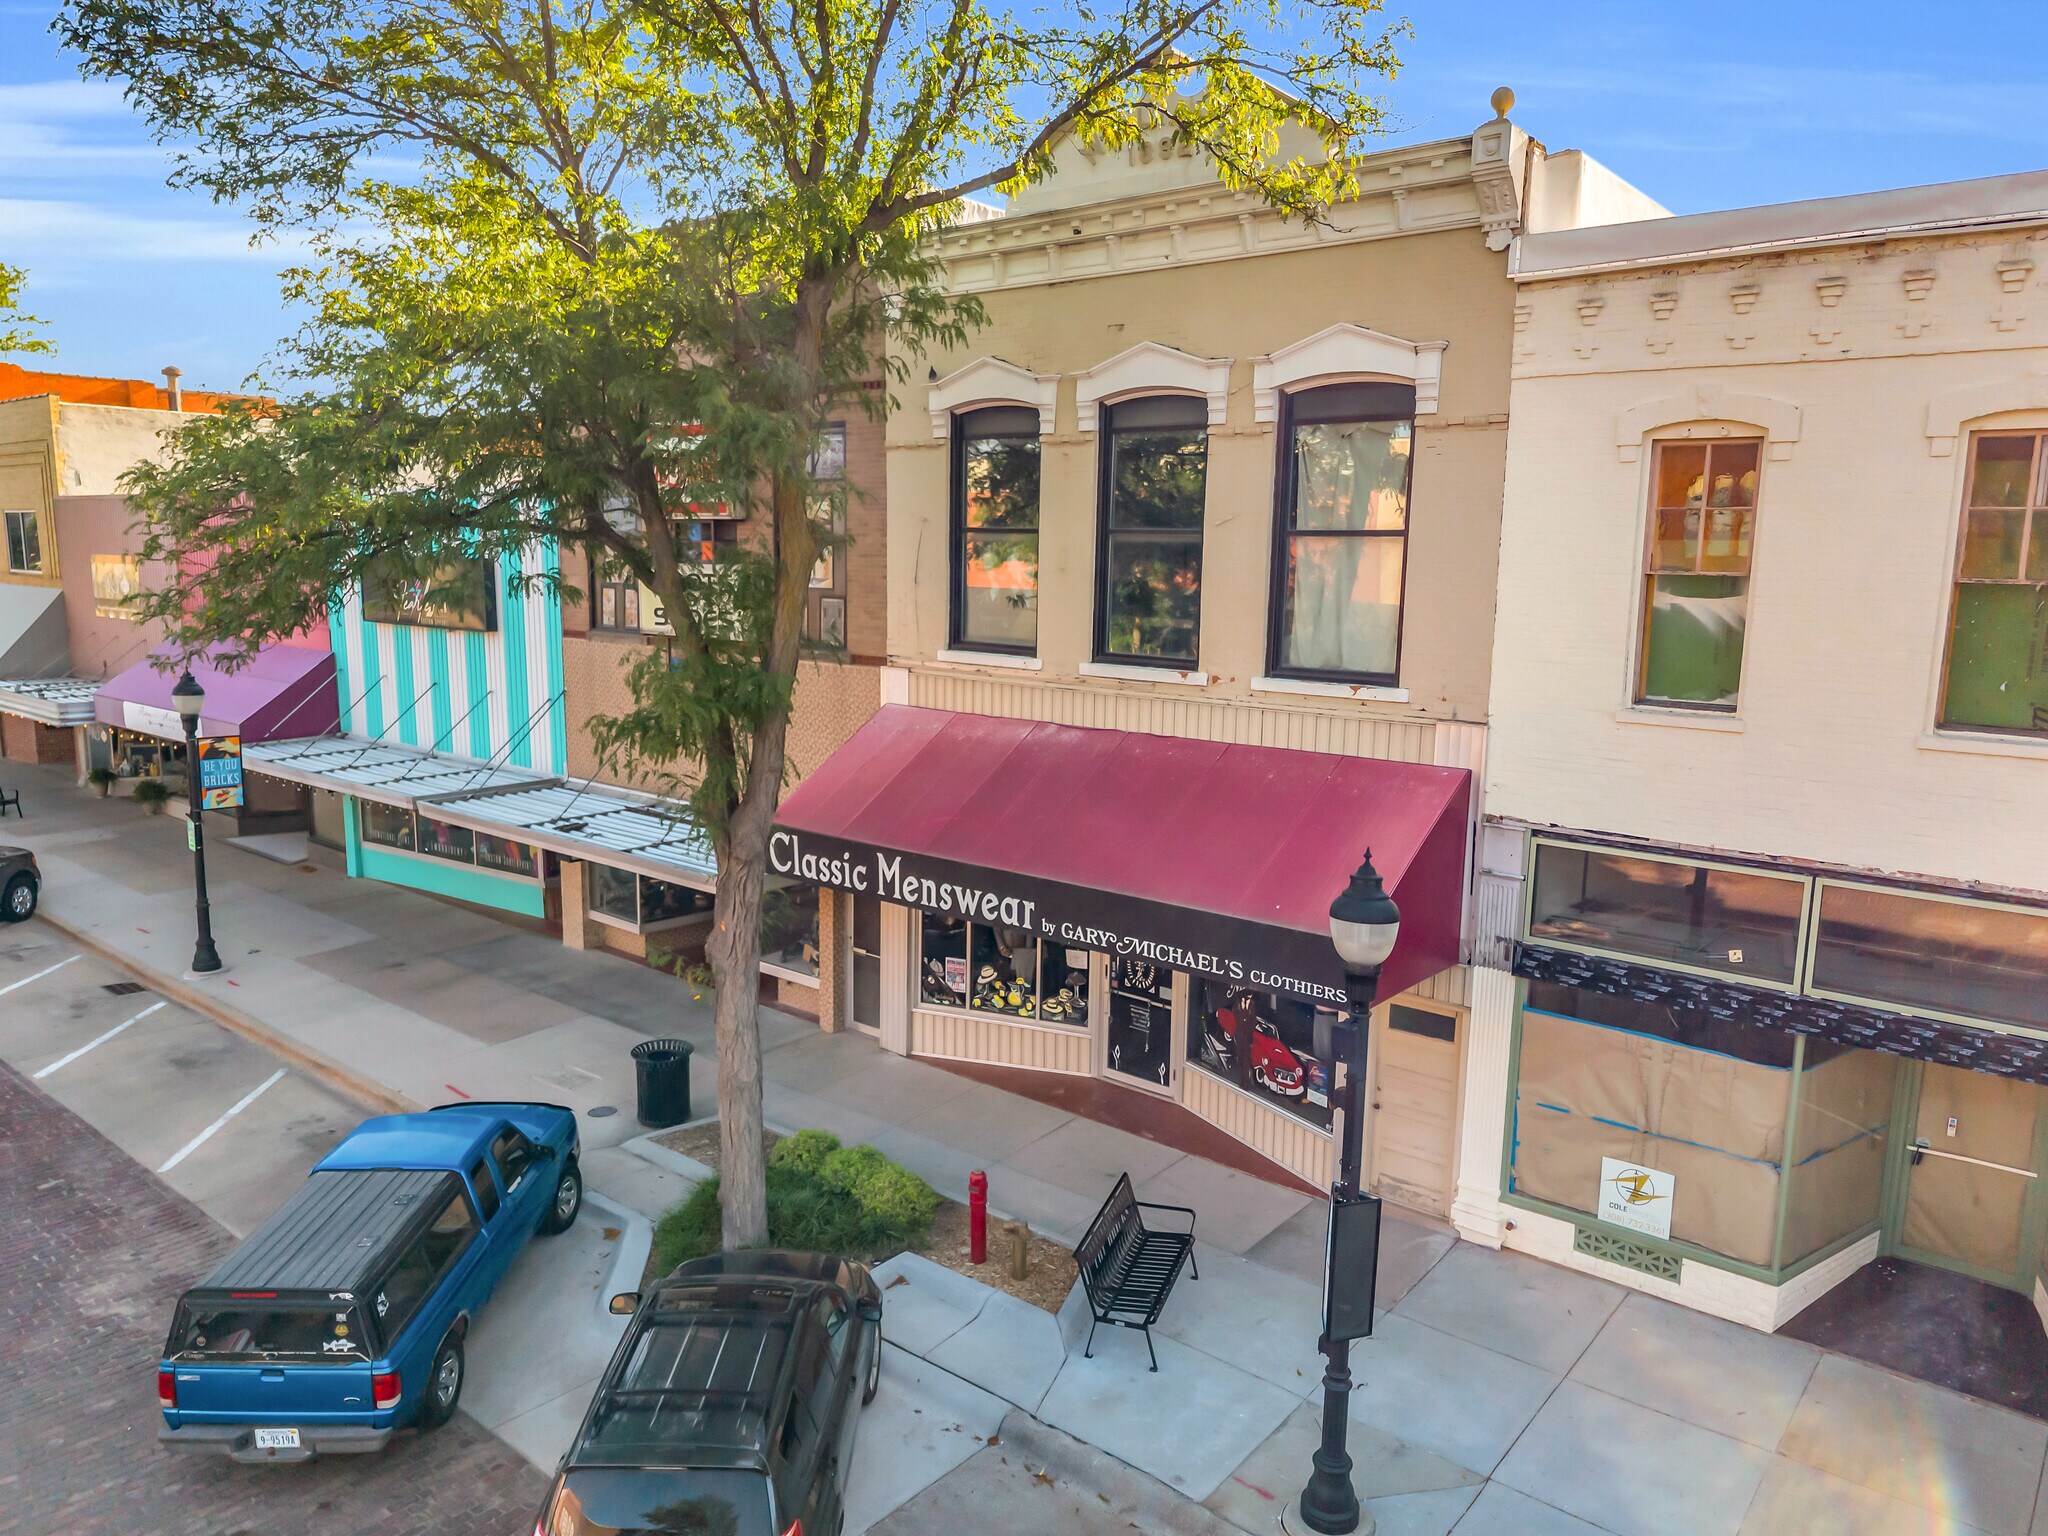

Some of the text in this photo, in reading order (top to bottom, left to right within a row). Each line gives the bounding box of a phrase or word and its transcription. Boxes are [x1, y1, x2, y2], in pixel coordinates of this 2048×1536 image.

[204, 759, 237, 772] BE YOU
[204, 773, 240, 787] BRICKS
[769, 831, 868, 891] Classic
[876, 852, 1035, 930] Menswear
[1041, 918, 1056, 936] by
[1061, 922, 1117, 948] GARY
[1116, 936, 1244, 979] MICHAEL'S
[1250, 970, 1348, 1003] CLOTHIERS
[1608, 1201, 1628, 1213] COLE
[260, 1435, 296, 1446] 9-9519A
